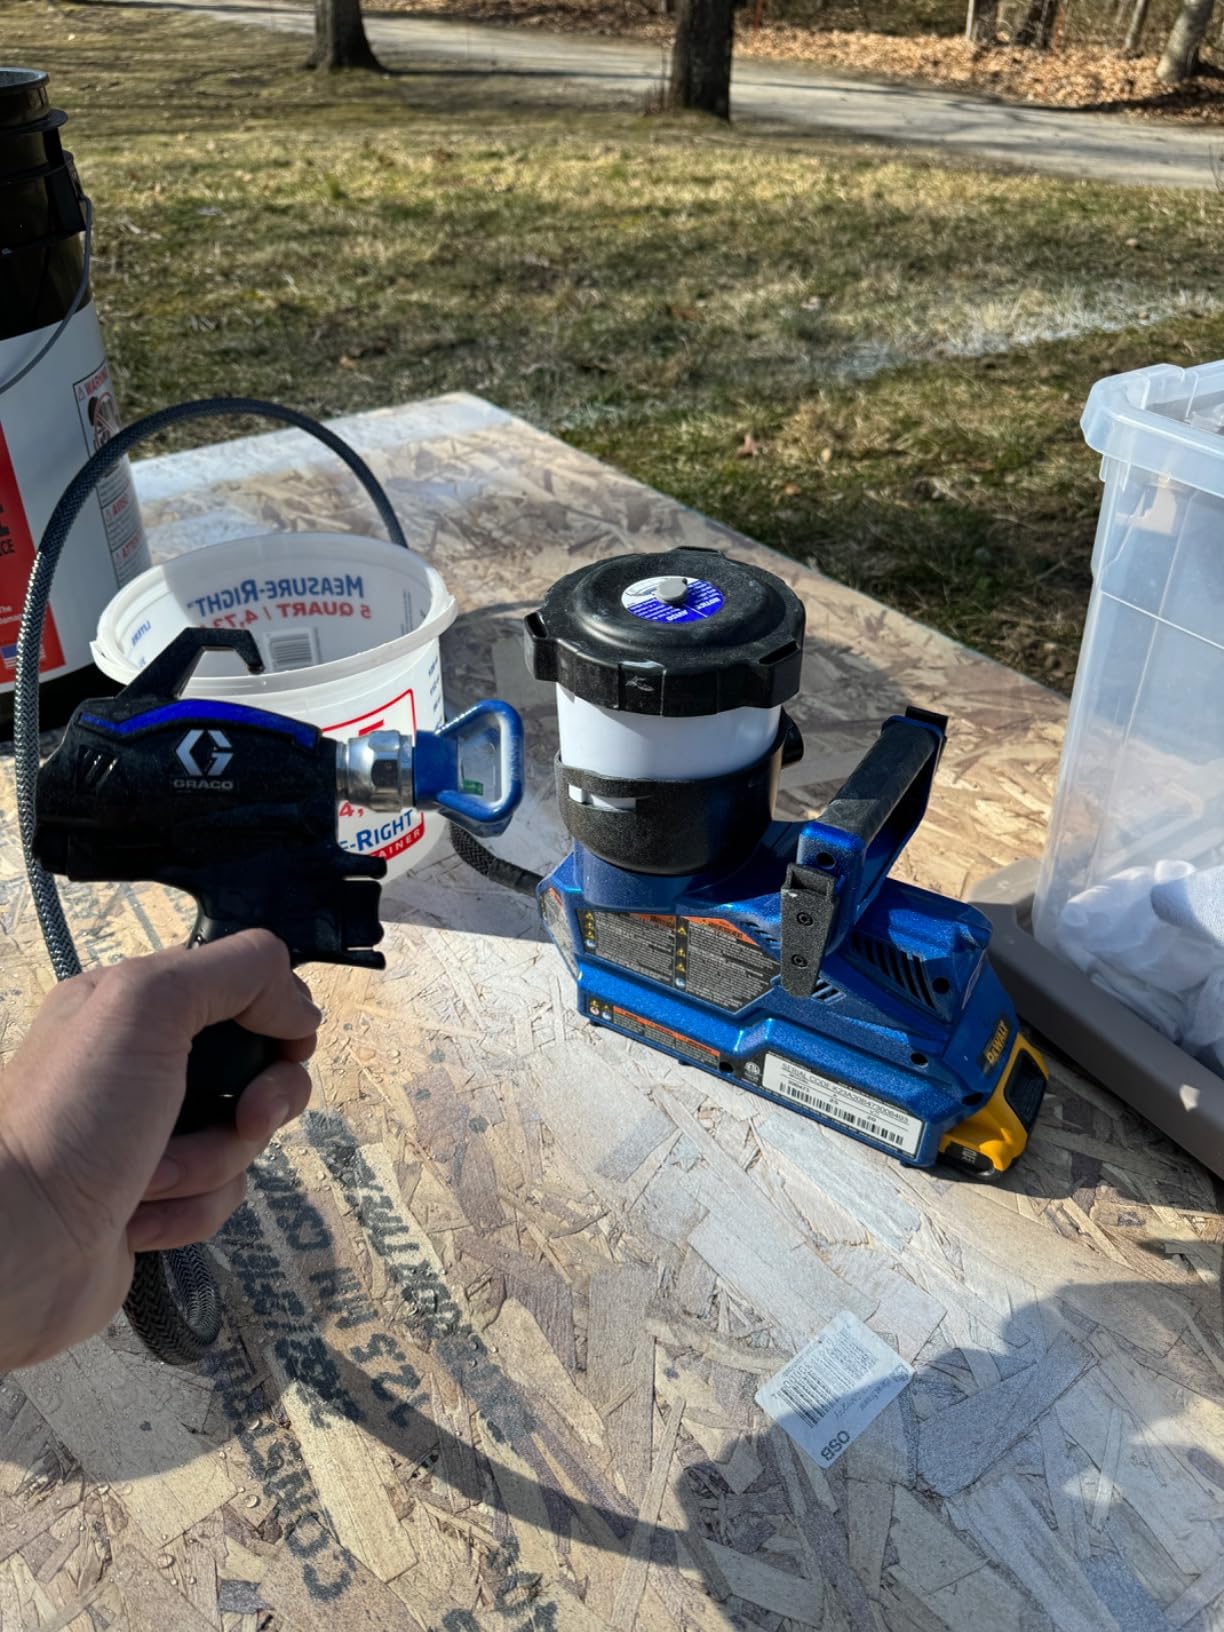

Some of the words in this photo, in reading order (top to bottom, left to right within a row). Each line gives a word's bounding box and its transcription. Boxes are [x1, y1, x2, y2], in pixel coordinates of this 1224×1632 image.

[173, 778, 234, 790] GRACO
[340, 808, 414, 852] E-RIGHT
[371, 828, 421, 858] AINER
[820, 1429, 851, 1462] OSB
